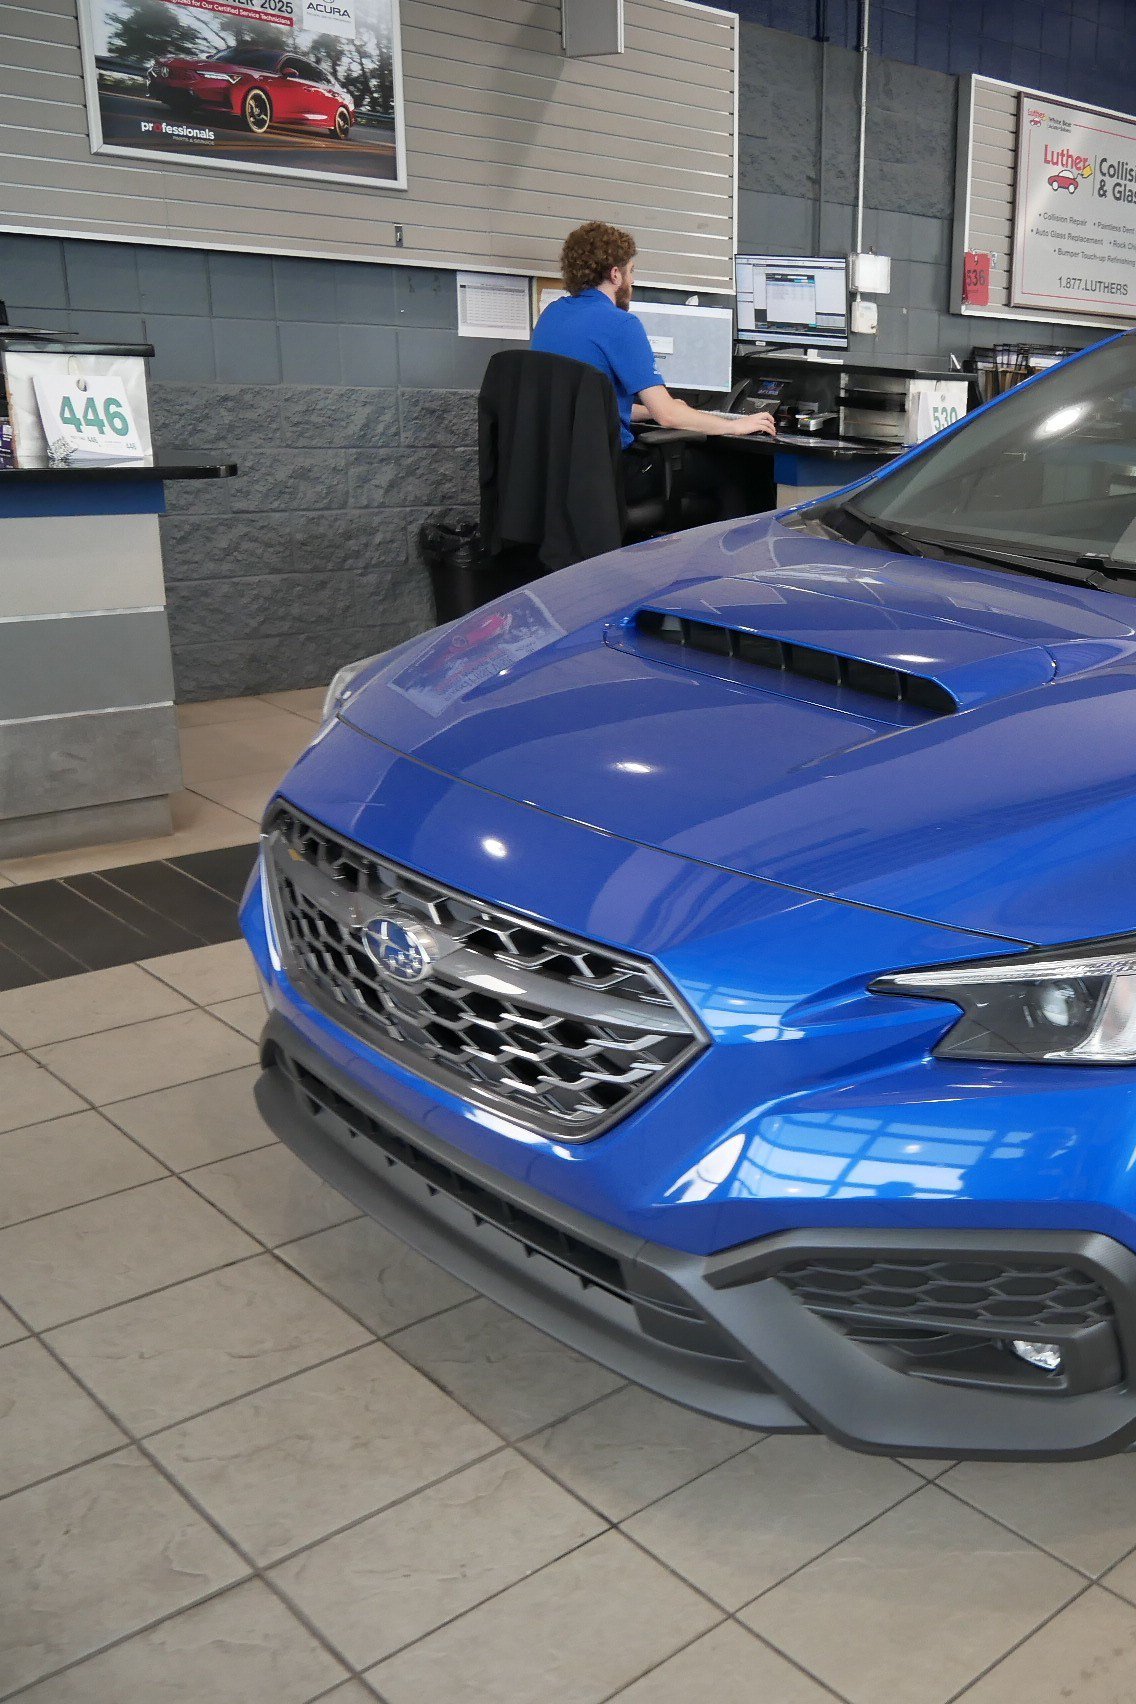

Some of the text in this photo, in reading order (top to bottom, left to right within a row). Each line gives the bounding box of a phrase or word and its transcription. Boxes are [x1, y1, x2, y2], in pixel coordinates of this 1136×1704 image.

[202, 1, 213, 9] Our
[214, 4, 239, 14] Certified
[240, 9, 260, 18] Service
[260, 13, 290, 24] Technicians
[261, 0, 293, 14] 2025
[306, 2, 351, 18] ACURA
[141, 121, 215, 139] professionals
[1044, 144, 1089, 171] Luther
[1097, 179, 1108, 198] &
[1043, 212, 1087, 226] Collision Repair
[1097, 221, 1121, 232] Paintless
[1122, 225, 1135, 234] Dent
[1035, 228, 1103, 246] Auto Glass Replacement
[1113, 240, 1126, 249] Rock
[1057, 248, 1080, 258] Bumper
[1081, 251, 1106, 262] Touch-up
[967, 269, 986, 286] 536
[1058, 275, 1129, 296] 1.877.LUTHERS
[59, 395, 129, 437] 446
